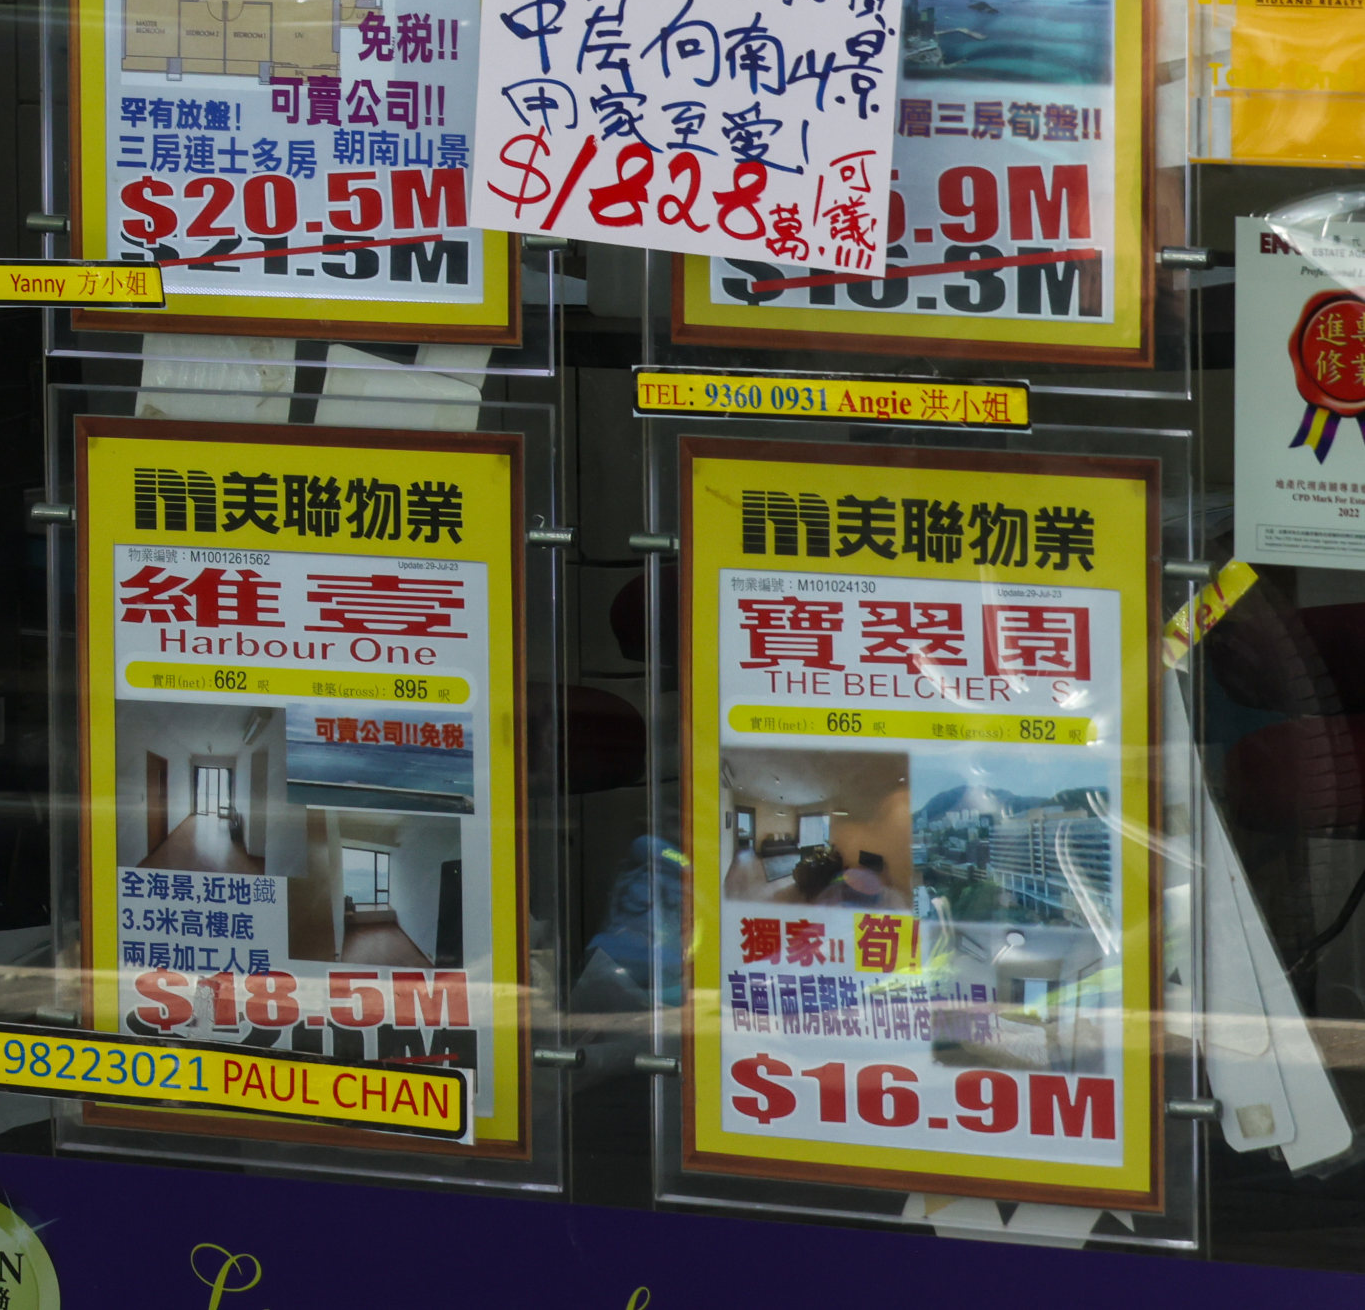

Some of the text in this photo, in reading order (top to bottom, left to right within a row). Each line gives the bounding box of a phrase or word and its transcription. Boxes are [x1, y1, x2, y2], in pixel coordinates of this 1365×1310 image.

[121, 98, 241, 131] 罕有放盤!
[269, 76, 445, 129] 可賣公司!!
[117, 128, 469, 179] 三房連士多房 朝南山景
[120, 167, 468, 244] $20.5M
[704, 384, 1011, 423] 9360 0931 Angie 洪小姐
[159, 628, 437, 666] Harbour One
[738, 596, 1091, 681] 寶翠園
[214, 671, 427, 699] 662 895
[764, 670, 830, 696] THE
[826, 712, 1055, 740] 665 852
[122, 907, 254, 940] 3.5米高樓底
[855, 913, 920, 974] 筍!
[133, 967, 470, 1032] $18.5M
[223, 1060, 449, 1119] PAUL CHAN
[730, 1052, 1116, 1139] $16.9M
